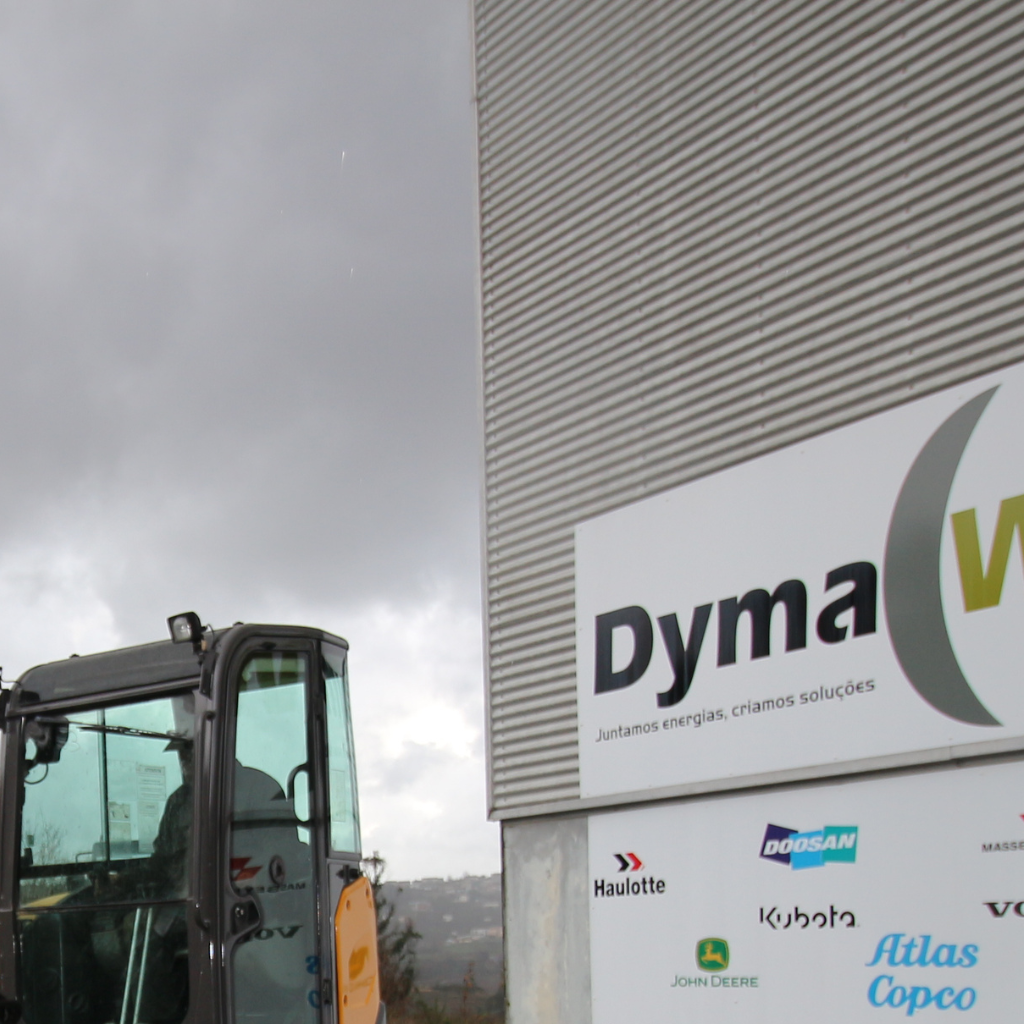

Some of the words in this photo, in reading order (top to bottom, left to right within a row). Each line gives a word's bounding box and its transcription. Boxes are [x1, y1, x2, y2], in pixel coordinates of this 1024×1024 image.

[594, 560, 877, 709] Dyma
[595, 720, 659, 743] Juntamos
[662, 707, 728, 729] energias,
[731, 693, 795, 718] criamos
[799, 679, 876, 706] soluções
[762, 832, 857, 856] DOOSAN
[593, 876, 666, 898] Haulotte
[759, 904, 856, 930] Kubota
[865, 933, 980, 968] Atlas
[670, 975, 708, 988] JOHN
[711, 975, 759, 988] DEERE
[866, 974, 978, 1017] Copco
